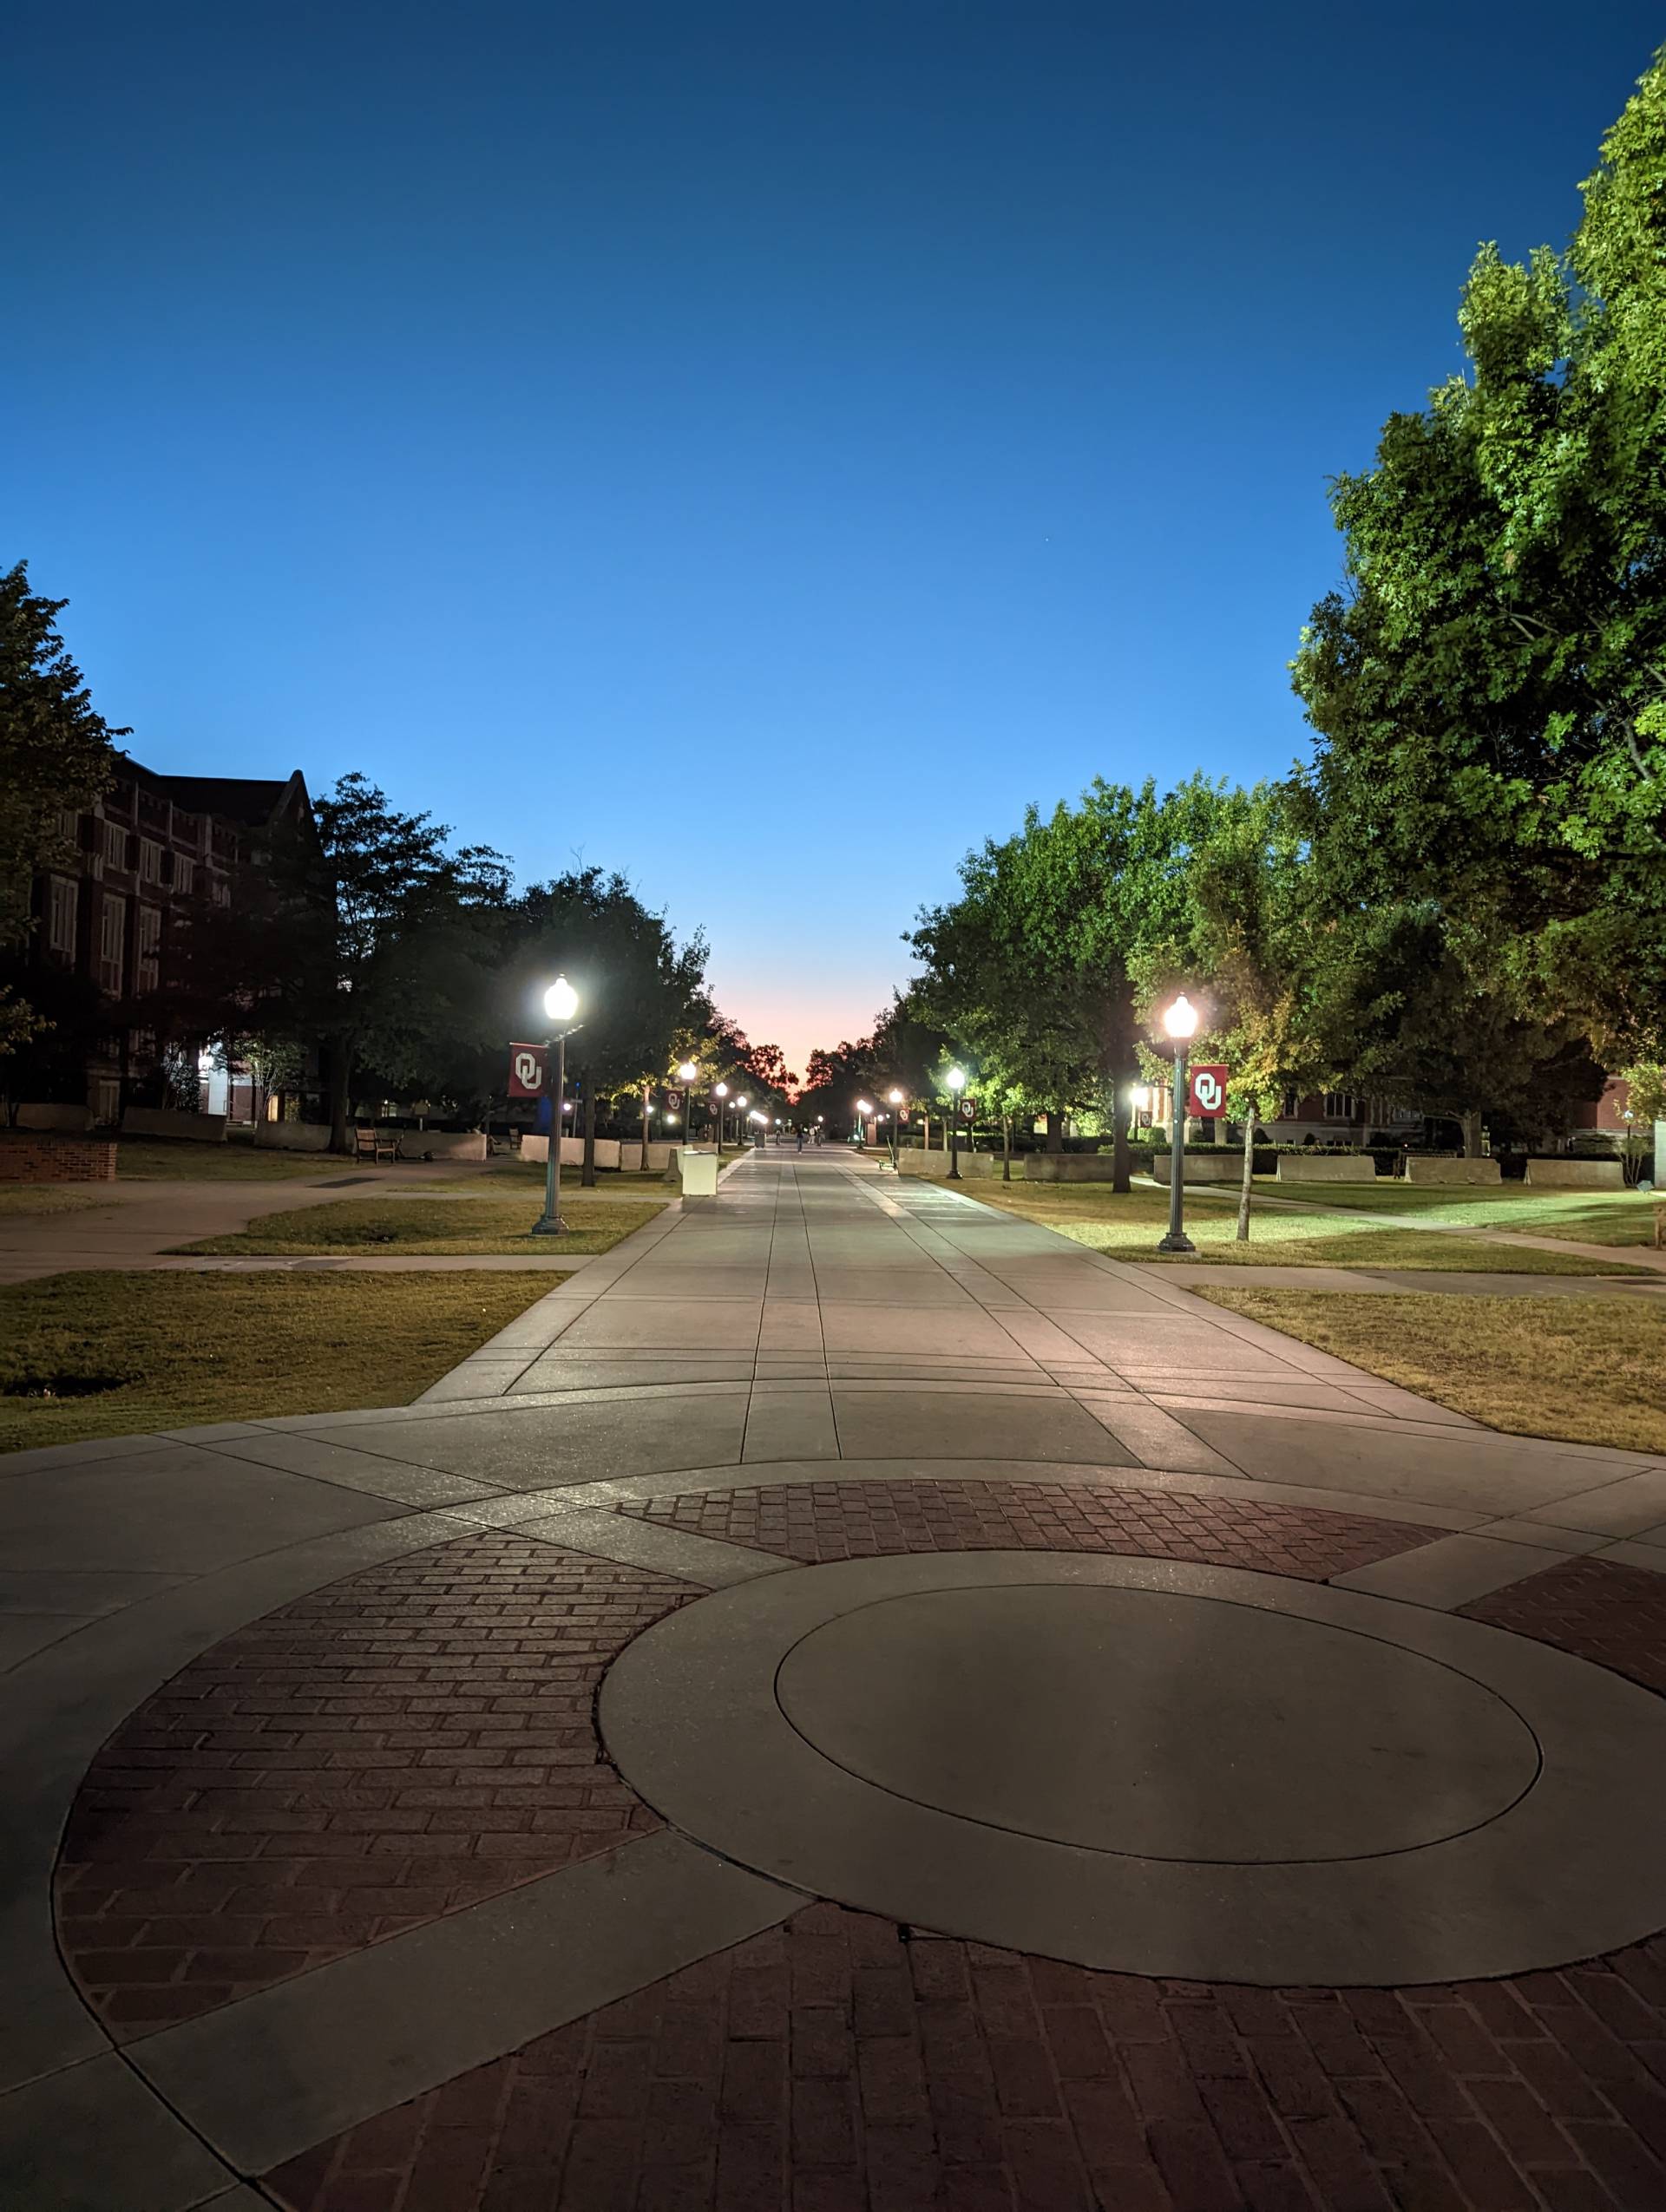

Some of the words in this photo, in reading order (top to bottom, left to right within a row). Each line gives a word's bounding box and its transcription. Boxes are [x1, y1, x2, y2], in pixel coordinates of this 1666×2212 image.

[515, 1052, 541, 1090] OU
[961, 1101, 974, 1117] OU
[1195, 1073, 1222, 1110] OU
